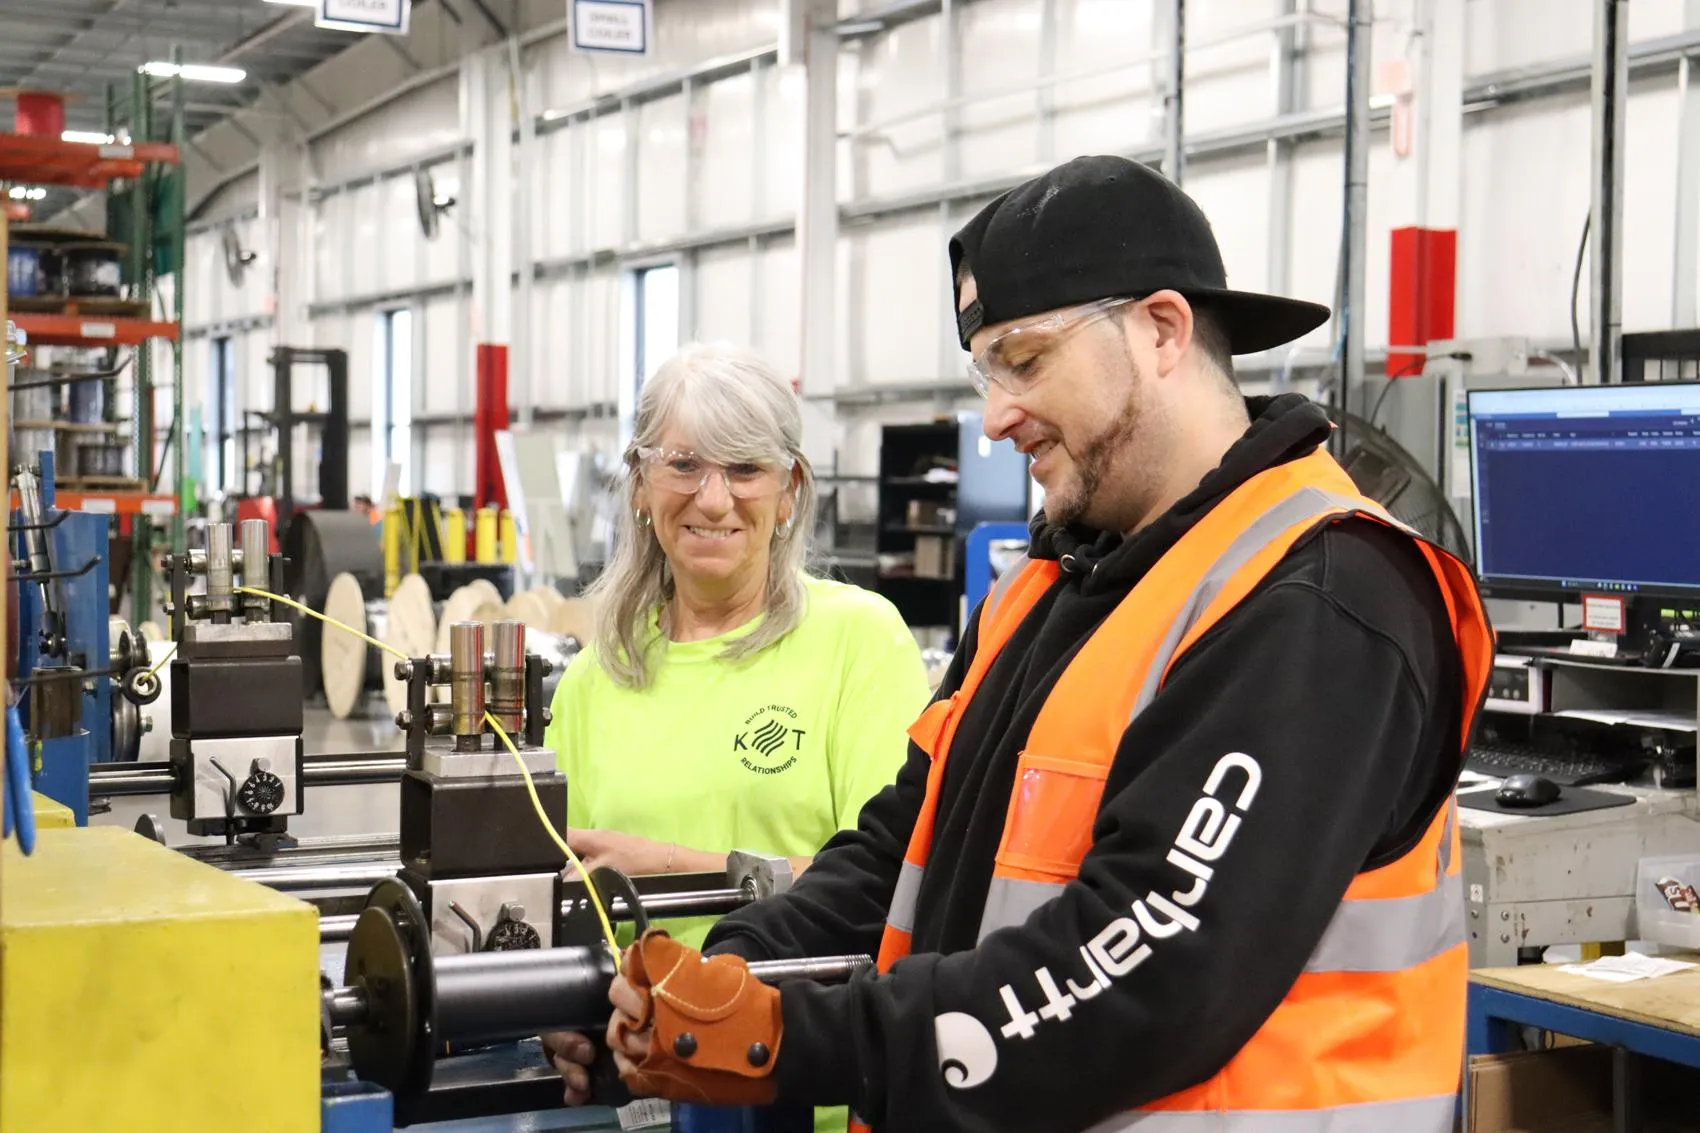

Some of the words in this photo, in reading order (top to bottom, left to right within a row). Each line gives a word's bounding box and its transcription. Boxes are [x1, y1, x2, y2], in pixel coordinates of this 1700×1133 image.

[745, 707, 765, 725] BUILD
[767, 704, 798, 719] TRUSTED
[740, 756, 798, 775] RELATIONSHIPS
